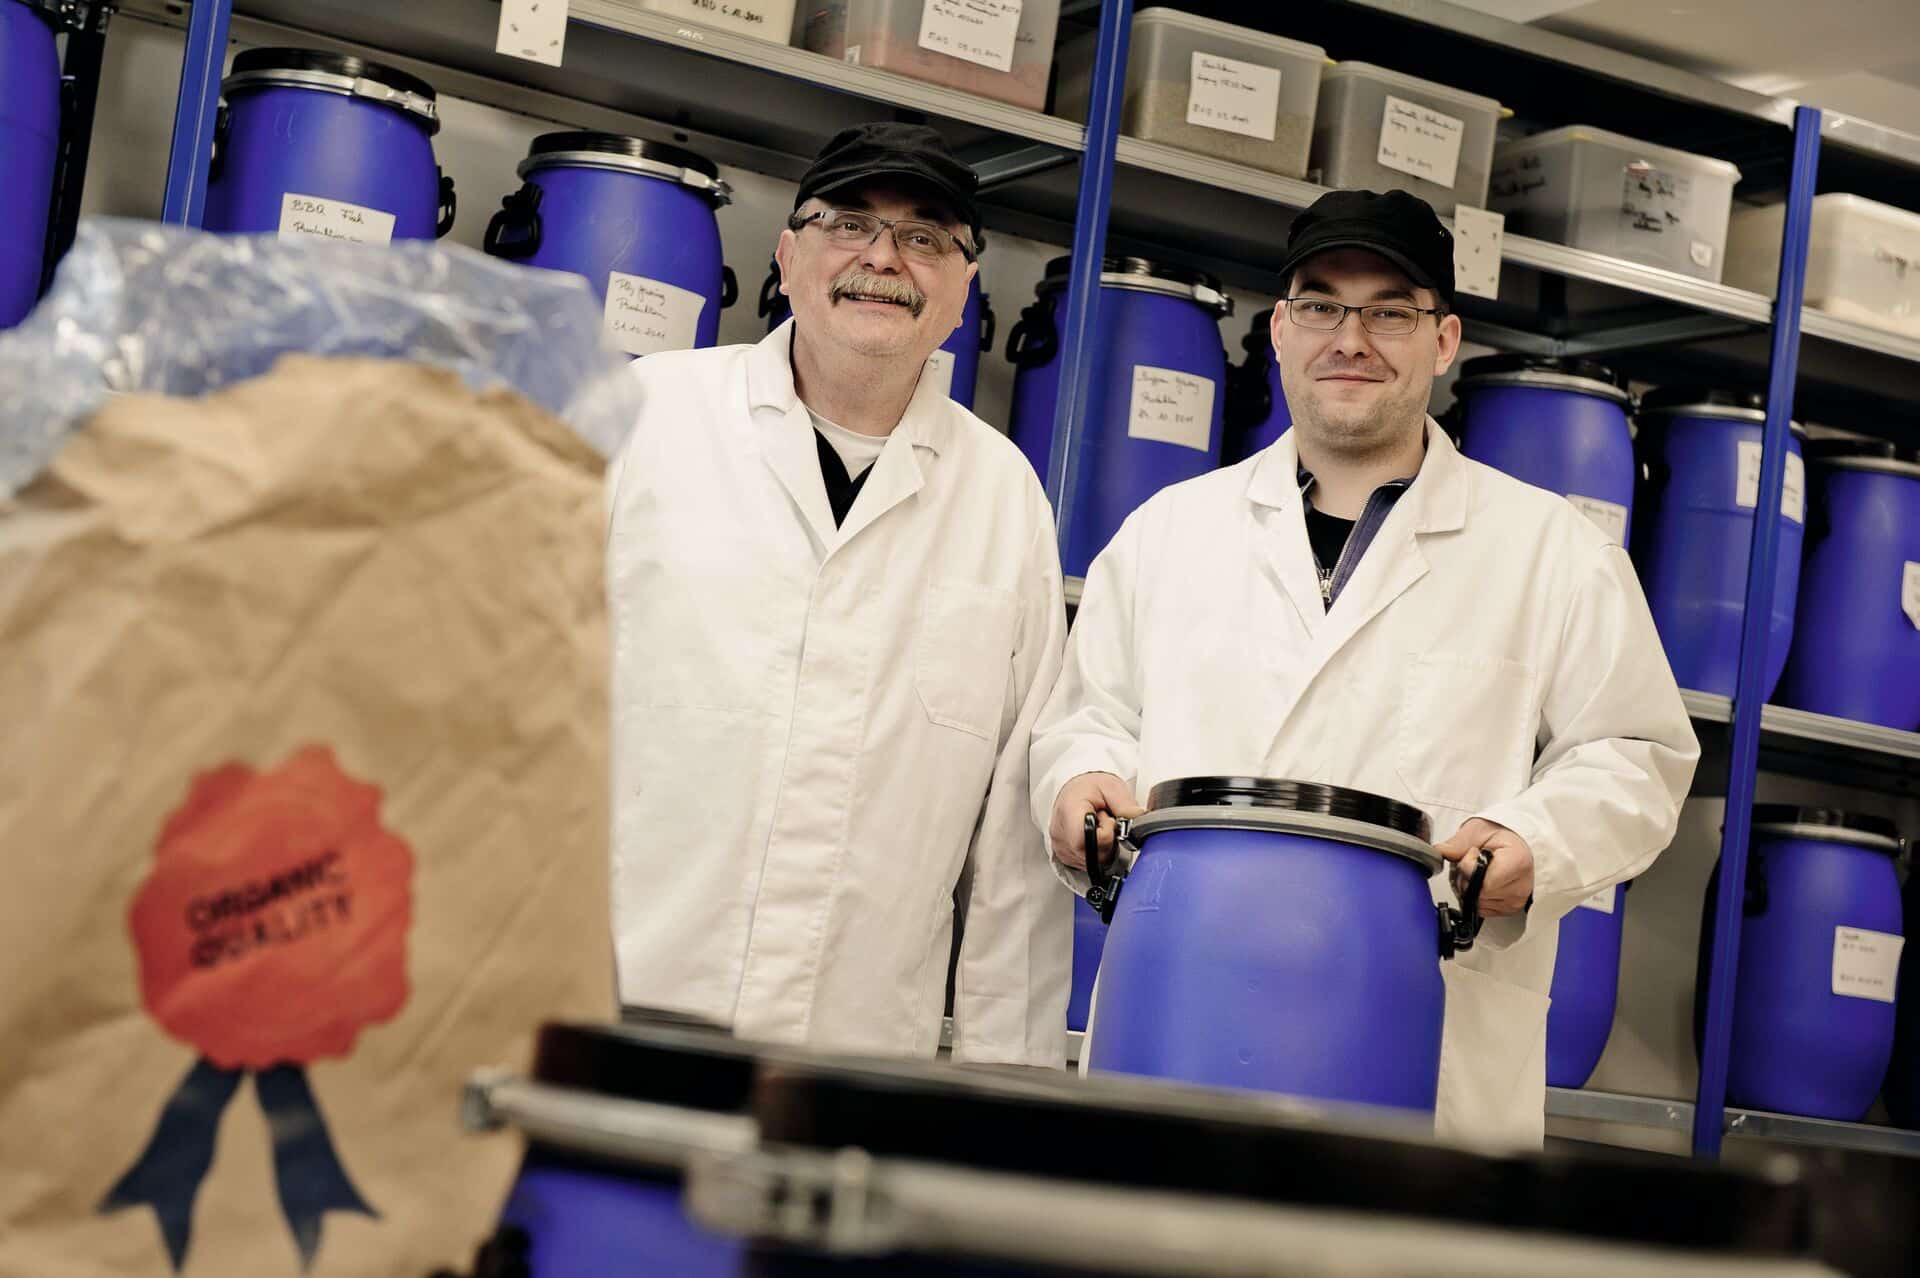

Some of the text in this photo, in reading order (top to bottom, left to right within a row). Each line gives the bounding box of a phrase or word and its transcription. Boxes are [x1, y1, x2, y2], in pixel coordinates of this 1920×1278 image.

[291, 199, 327, 216] BBQ
[185, 847, 346, 934] ORGANIC
[190, 888, 352, 970] QUALITY
